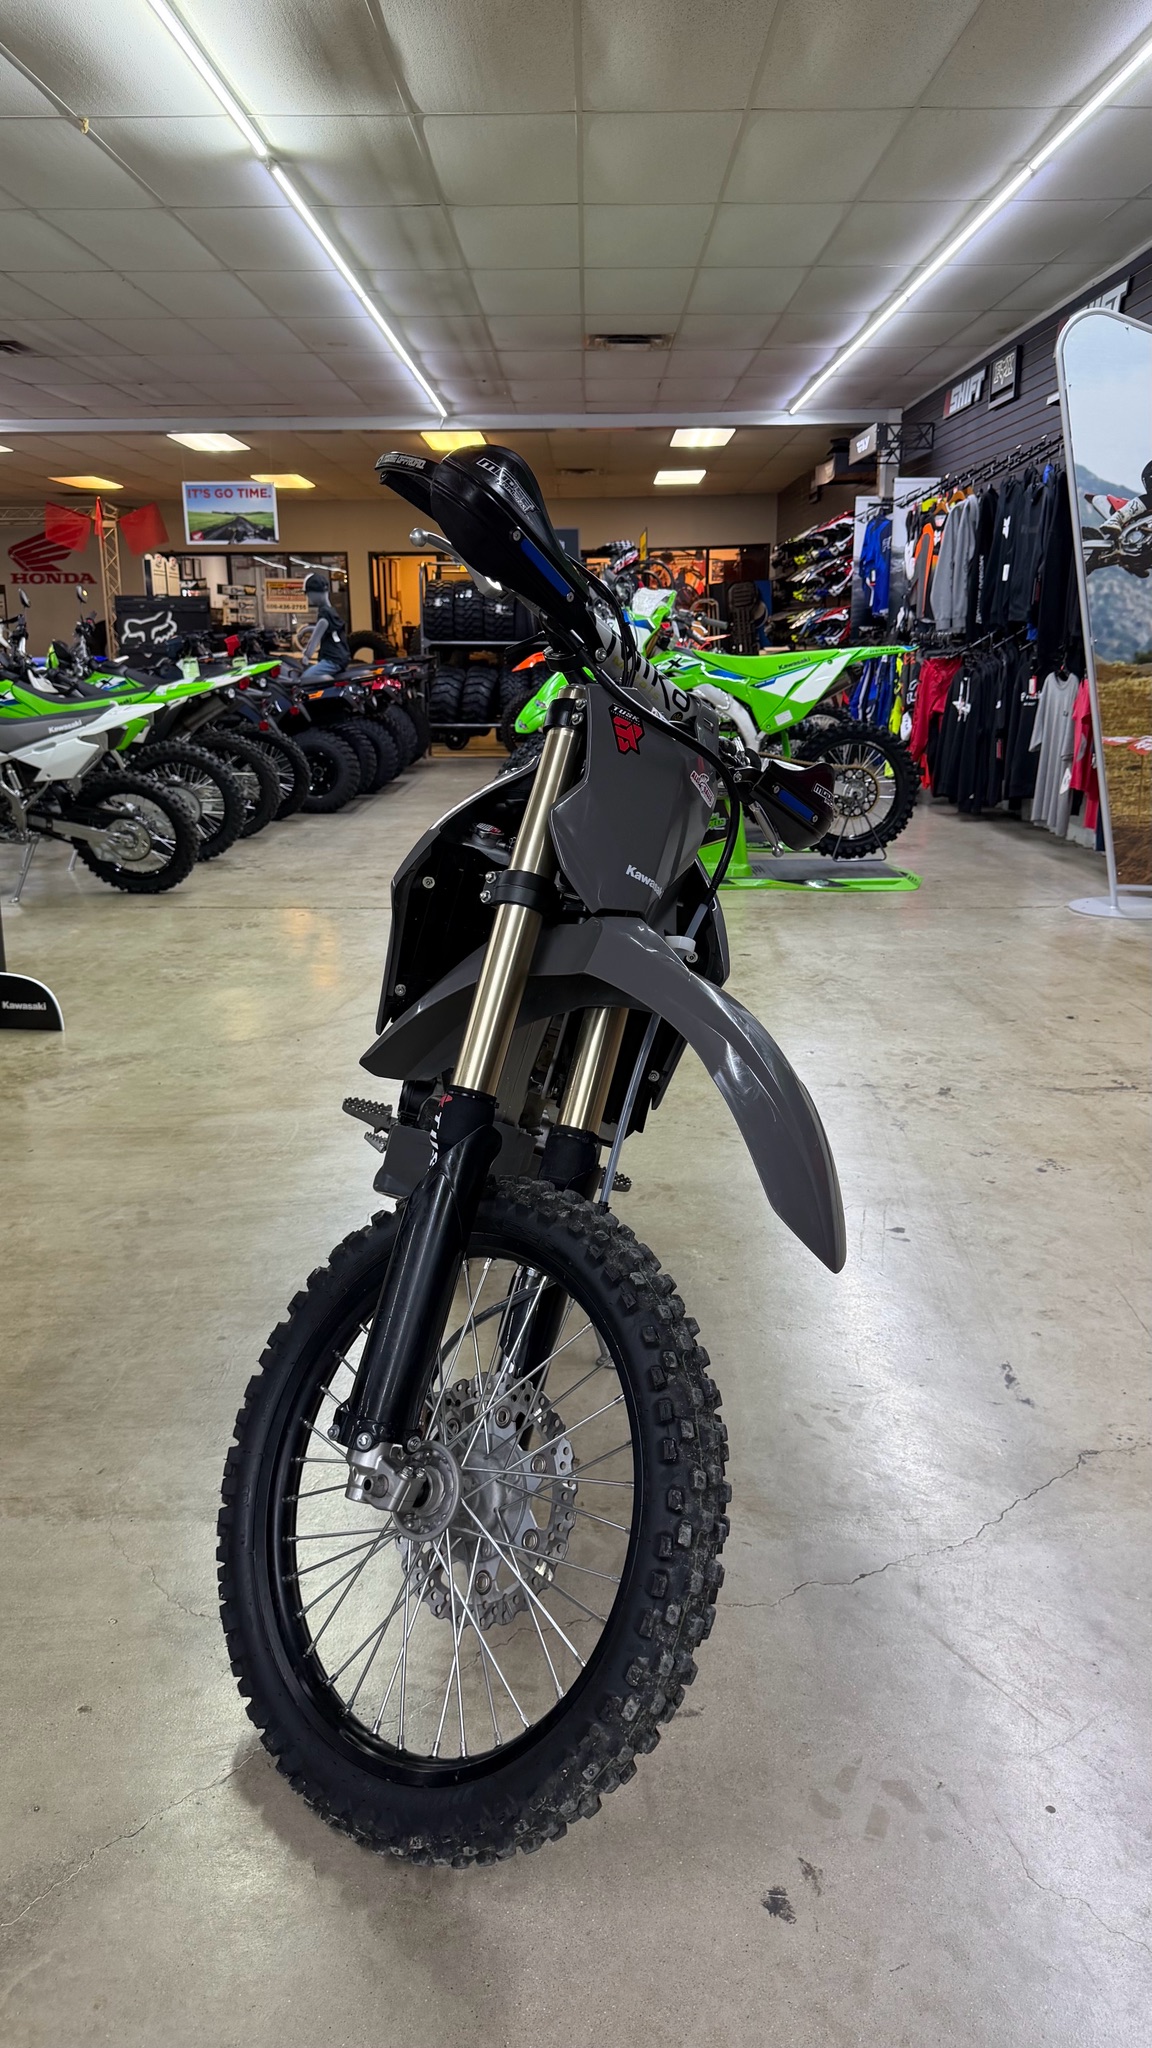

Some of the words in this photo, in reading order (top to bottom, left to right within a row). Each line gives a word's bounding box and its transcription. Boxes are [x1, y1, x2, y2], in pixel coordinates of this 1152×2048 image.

[948, 369, 987, 415] SHIFT
[187, 488, 211, 499] IT'S
[214, 488, 234, 499] GO
[237, 488, 272, 499] TIME.
[10, 572, 97, 585] HONDA
[778, 656, 811, 671] Kawasaki
[612, 705, 641, 721] TUSK
[48, 719, 83, 734] Kawasaki
[1, 1000, 47, 1011] Kawasaki
